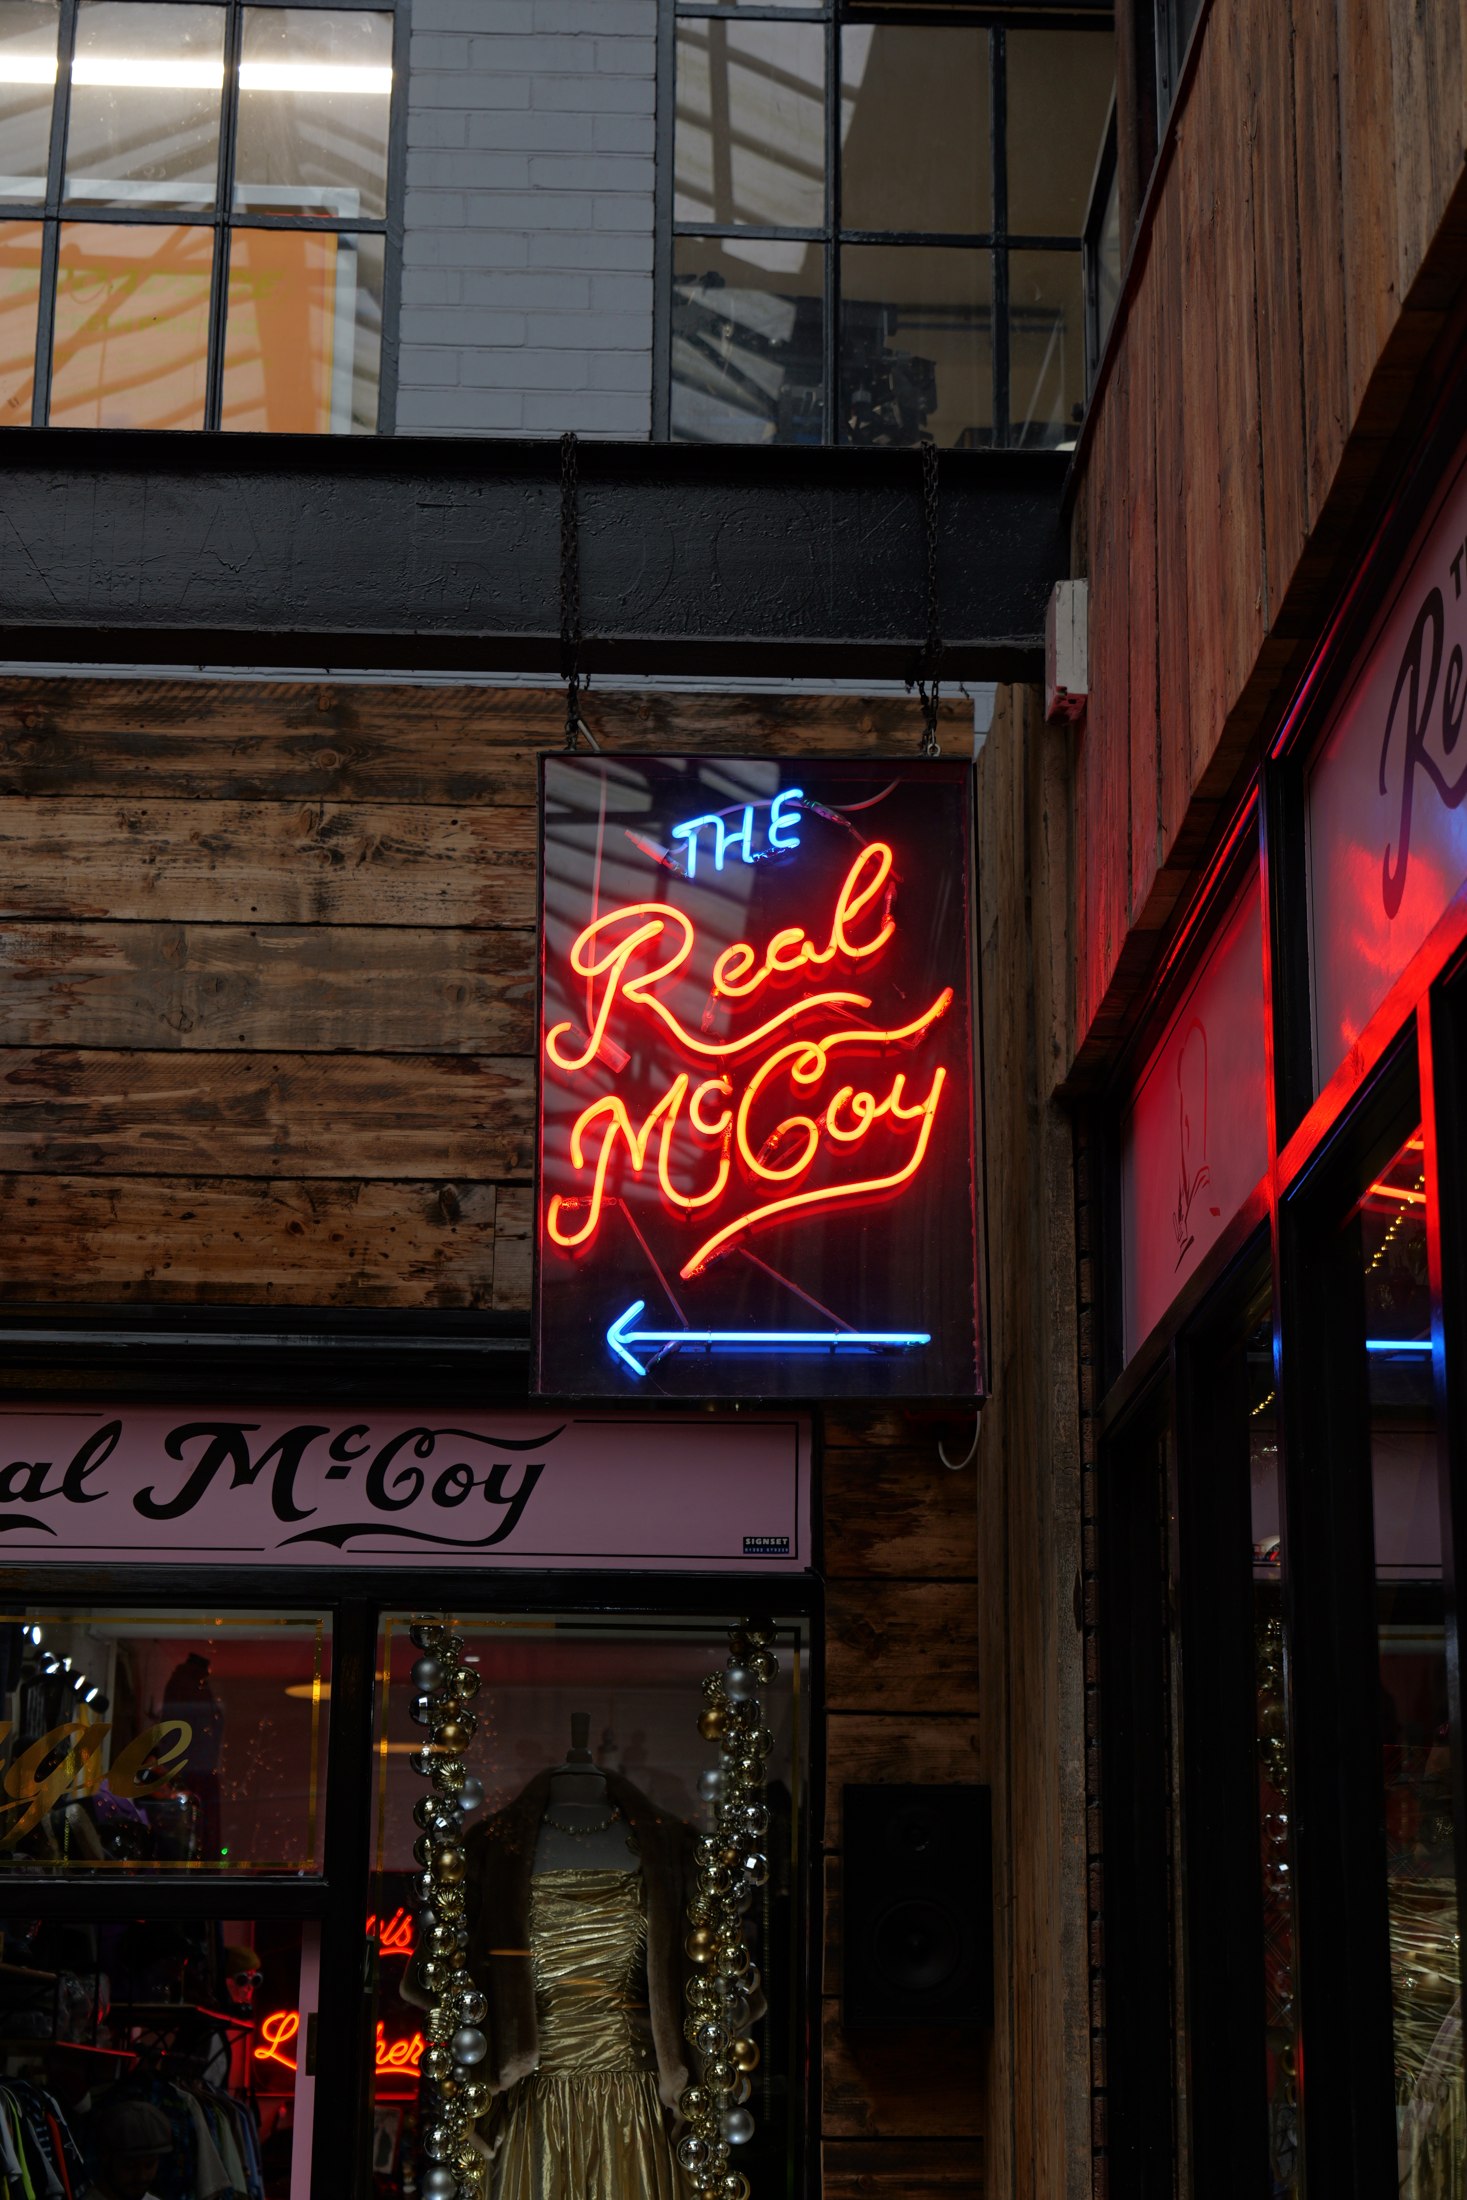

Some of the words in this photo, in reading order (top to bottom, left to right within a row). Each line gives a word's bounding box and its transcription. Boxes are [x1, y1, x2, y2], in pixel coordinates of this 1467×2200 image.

[1449, 536, 1467, 601] T
[671, 787, 804, 877] THE
[546, 842, 895, 1070] Real
[547, 985, 954, 1279] McCoy
[132, 1421, 568, 1548] McCoy
[0, 1720, 193, 1851] ge
